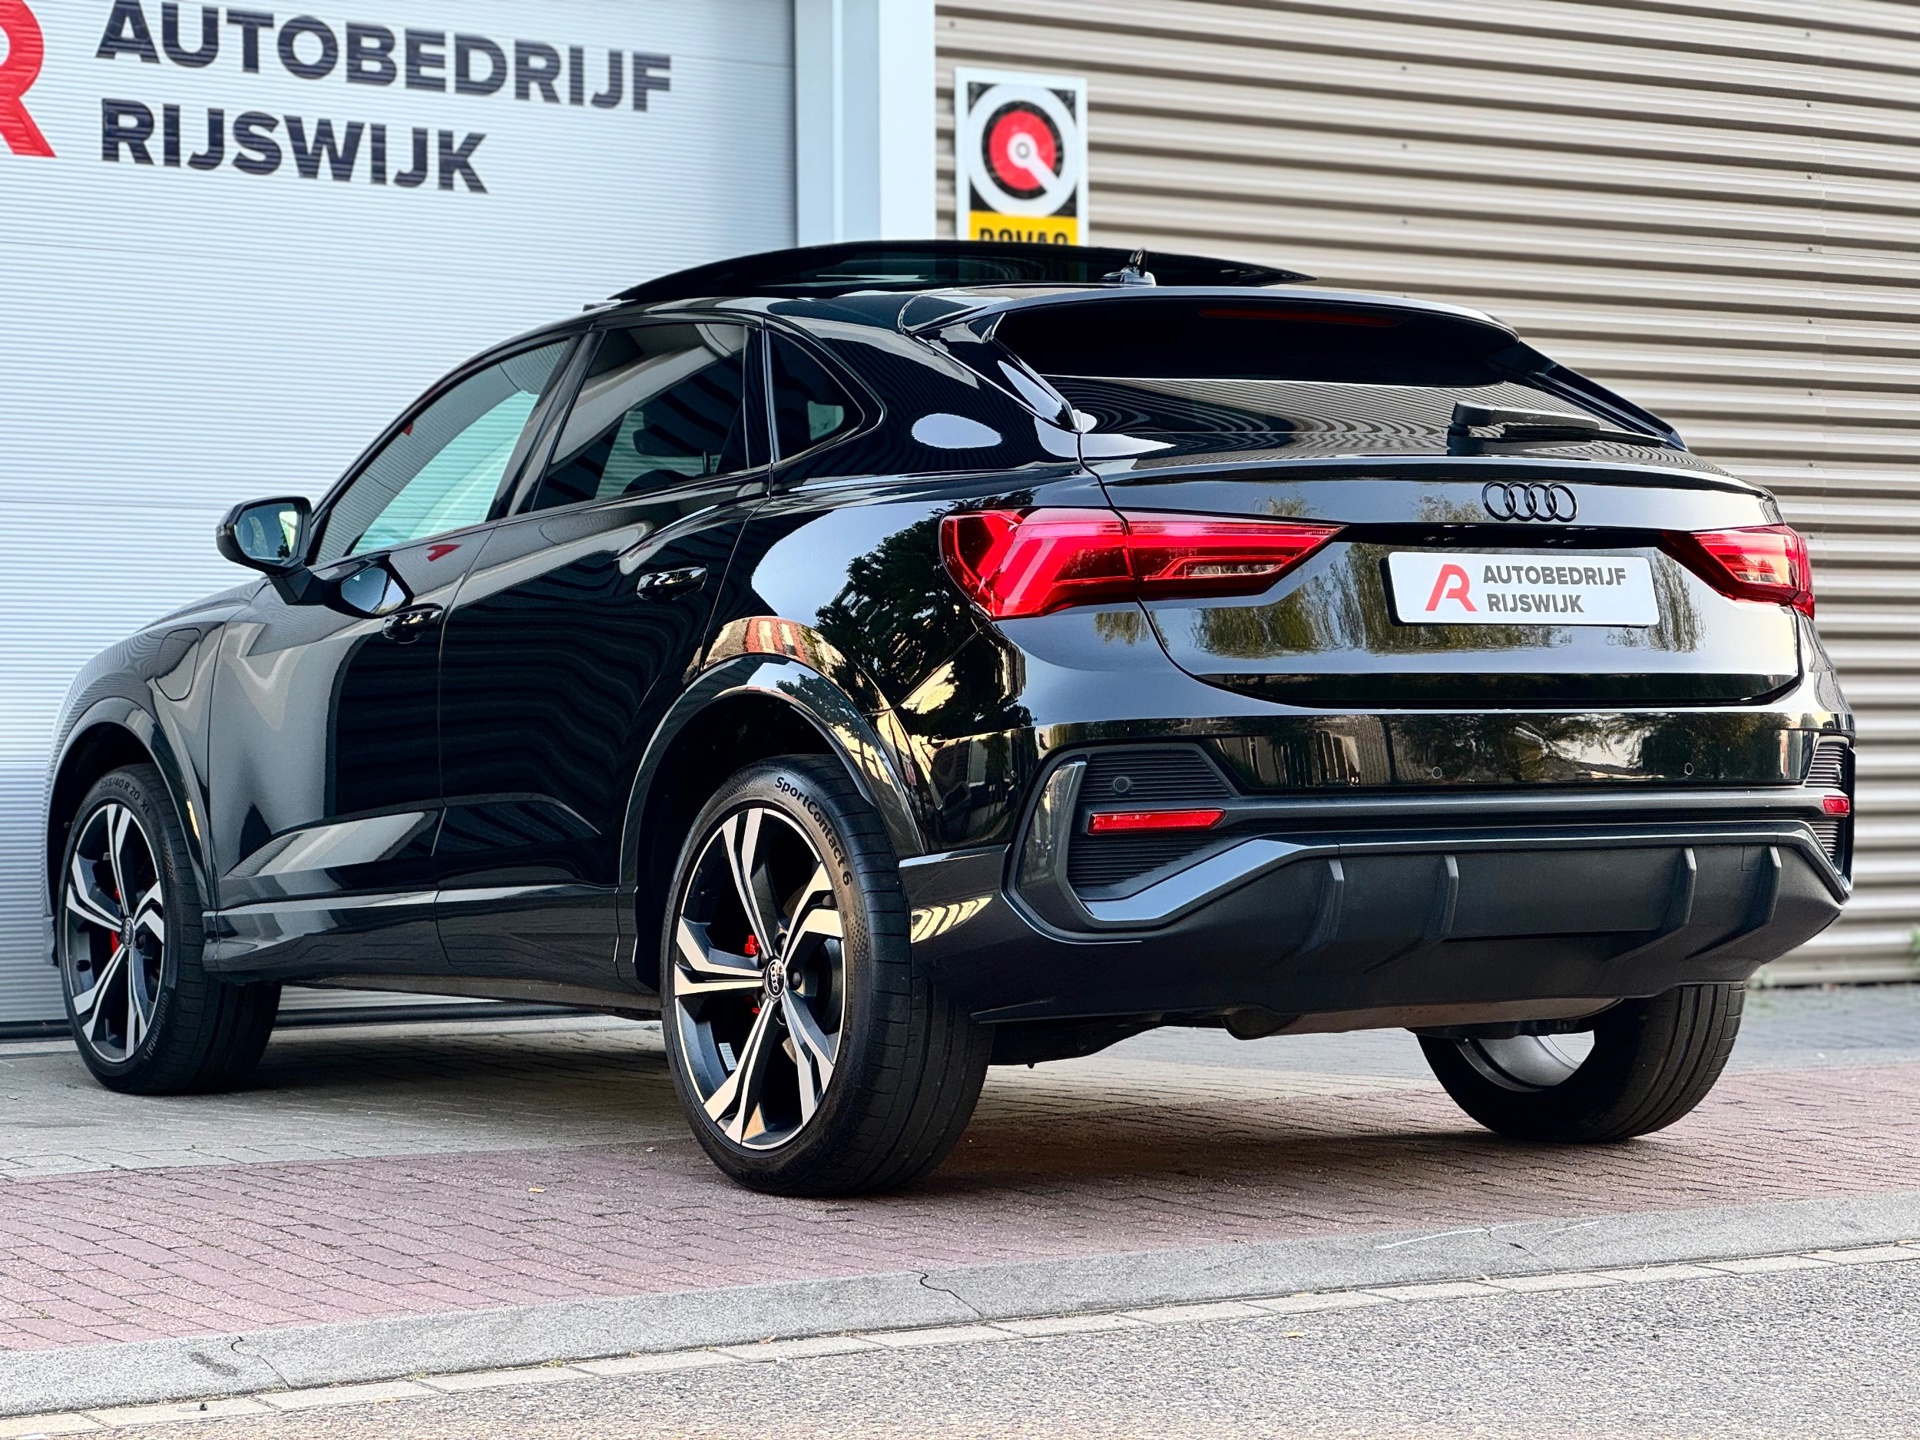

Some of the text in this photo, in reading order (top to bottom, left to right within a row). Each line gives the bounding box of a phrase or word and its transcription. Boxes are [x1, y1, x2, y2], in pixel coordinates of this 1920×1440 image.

[95, 0, 671, 112] AUTOBEDRIJF
[101, 98, 488, 194] RIJSWIJK
[1483, 565, 1627, 586] AUTOBEDRIJF
[1486, 593, 1585, 613] RIJSWIJK
[123, 781, 130, 791] R
[130, 786, 140, 800] 20
[141, 800, 150, 817] XL
[774, 776, 853, 886] SportContact 6
